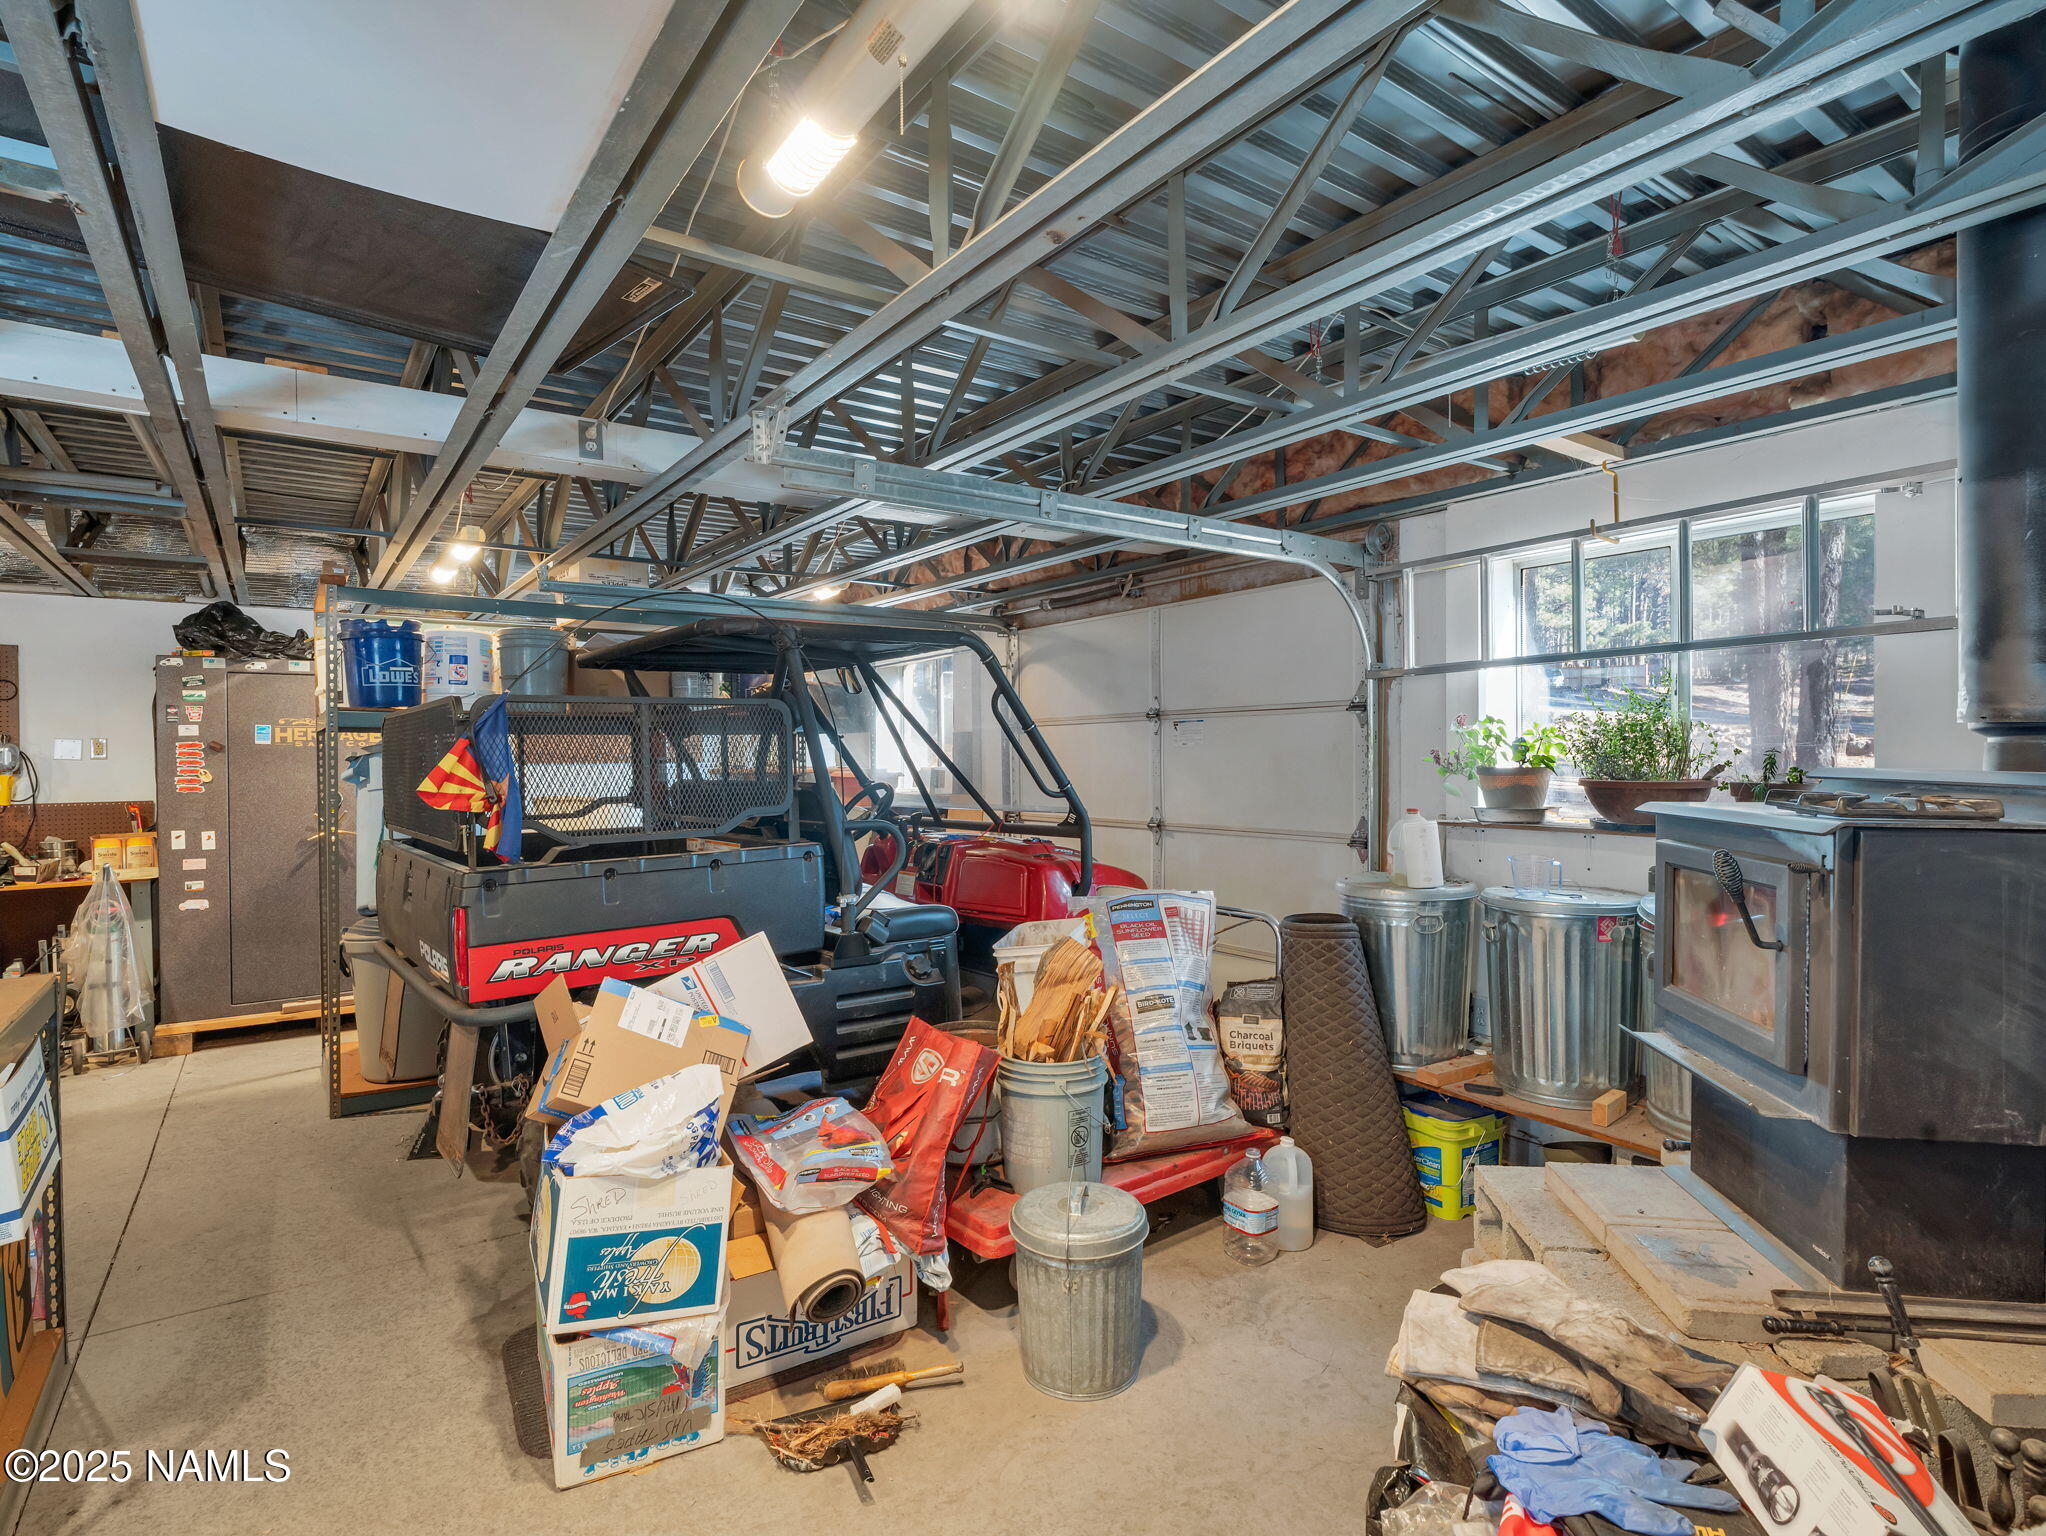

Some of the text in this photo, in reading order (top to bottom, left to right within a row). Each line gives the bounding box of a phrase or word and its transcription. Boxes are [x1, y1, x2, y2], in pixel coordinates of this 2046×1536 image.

[1111, 902, 1153, 911] PENNINGTON
[1116, 926, 1163, 935] SUNFLOWER
[513, 944, 564, 956] POLARIS
[489, 932, 721, 984] RANGER
[634, 954, 700, 973] XP
[1229, 1030, 1273, 1041] Charcoal
[1229, 1041, 1274, 1051] Briquets
[579, 1346, 627, 1371] DELICIOUS
